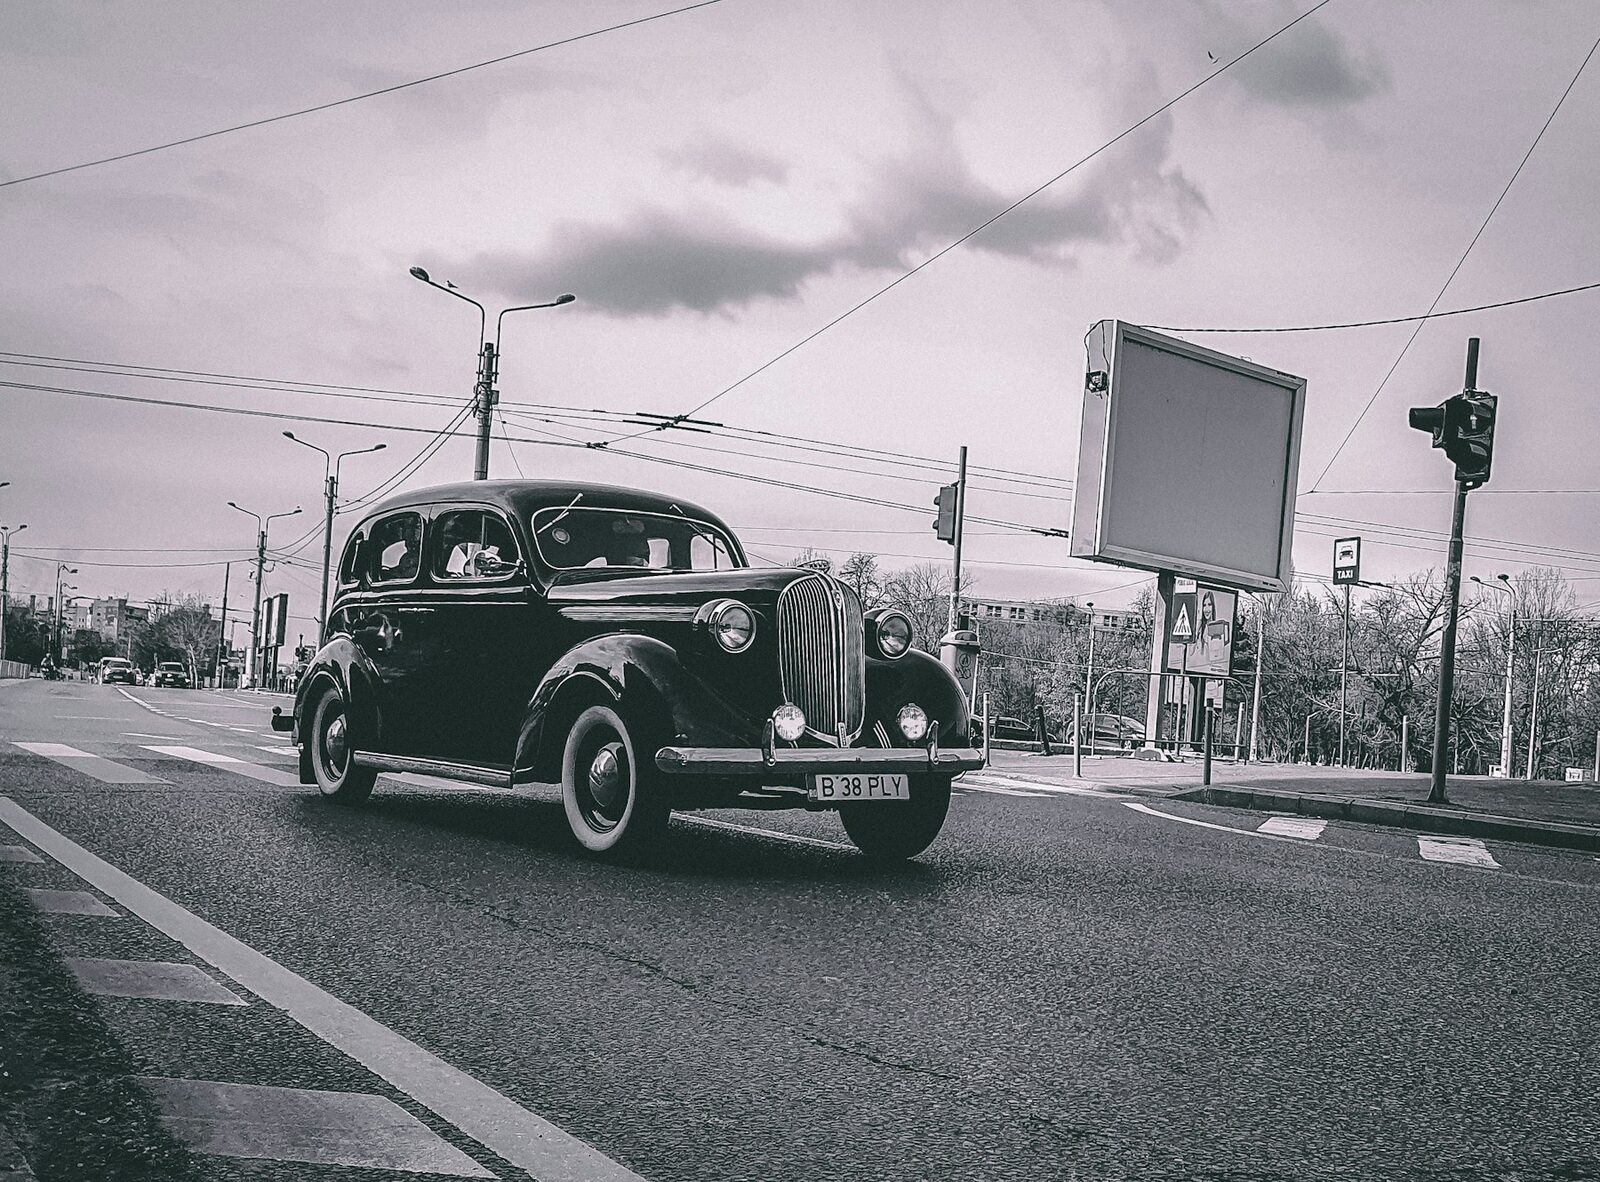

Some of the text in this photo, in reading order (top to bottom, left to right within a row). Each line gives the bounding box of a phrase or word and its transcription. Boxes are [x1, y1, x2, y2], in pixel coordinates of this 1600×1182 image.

[1336, 570, 1353, 579] TAXI
[821, 776, 901, 797] B 38 PLY
